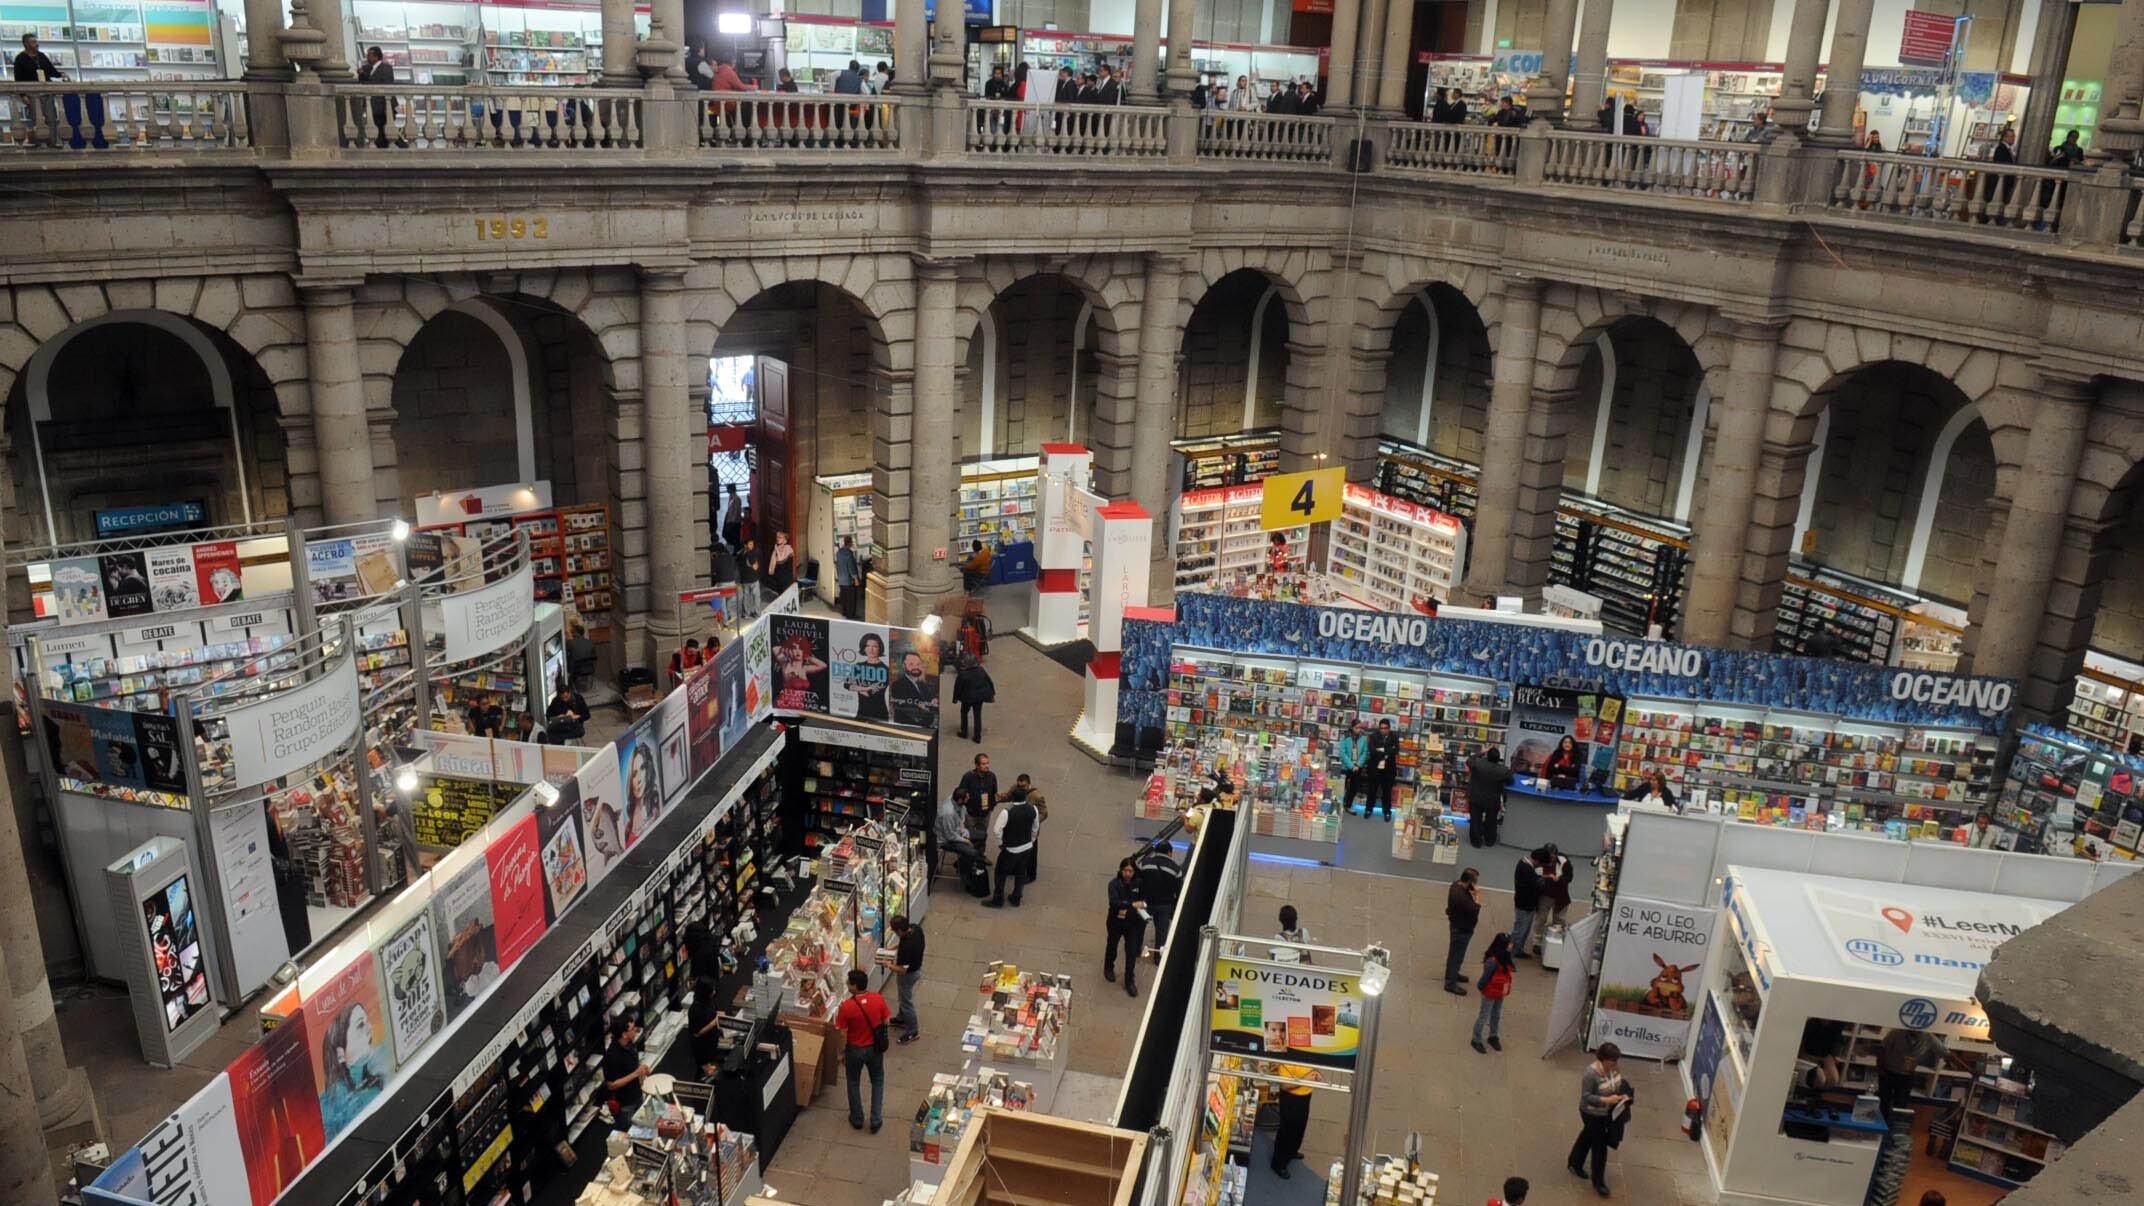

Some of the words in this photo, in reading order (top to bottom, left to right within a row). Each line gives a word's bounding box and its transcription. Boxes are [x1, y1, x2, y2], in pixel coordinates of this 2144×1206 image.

[475, 215, 549, 241] 1992
[1236, 485, 1264, 499] CÁTED
[1290, 479, 1316, 516] 4
[102, 510, 179, 528] RECEPCIÓN
[152, 559, 174, 567] Mares
[311, 548, 345, 562] ACERO
[231, 615, 262, 627] DEBATE
[784, 620, 817, 631] LAURA
[1318, 610, 1428, 648] OCEANO
[143, 626, 175, 639] DEBATE
[776, 626, 825, 640] ESQUIVEL
[46, 640, 86, 653] Lumen
[831, 646, 857, 664] YO
[1586, 638, 1702, 678] OCEANO
[831, 660, 887, 682] DECIDO
[1547, 676, 1595, 691] CAJA
[1891, 672, 2013, 713] OCEANO
[270, 695, 327, 728] Penguin
[1516, 692, 1564, 709] BUCAY
[90, 728, 136, 744] Mafalda
[273, 714, 328, 744] Random
[273, 734, 318, 760] Grupo
[606, 901, 633, 935] AGUILAR
[1620, 906, 1634, 919] SI
[1640, 910, 1662, 924] NO
[1922, 914, 2021, 936] #LeerM
[1616, 921, 1640, 936] ME
[1643, 926, 1707, 946] ABURRO
[563, 943, 593, 981] AGUILAR
[1230, 967, 1349, 994] NOVEDADES
[398, 976, 430, 1020] 2015
[522, 990, 552, 1024] taurus
[1614, 1022, 1662, 1043] etrillas
[471, 1040, 503, 1077] taurus
